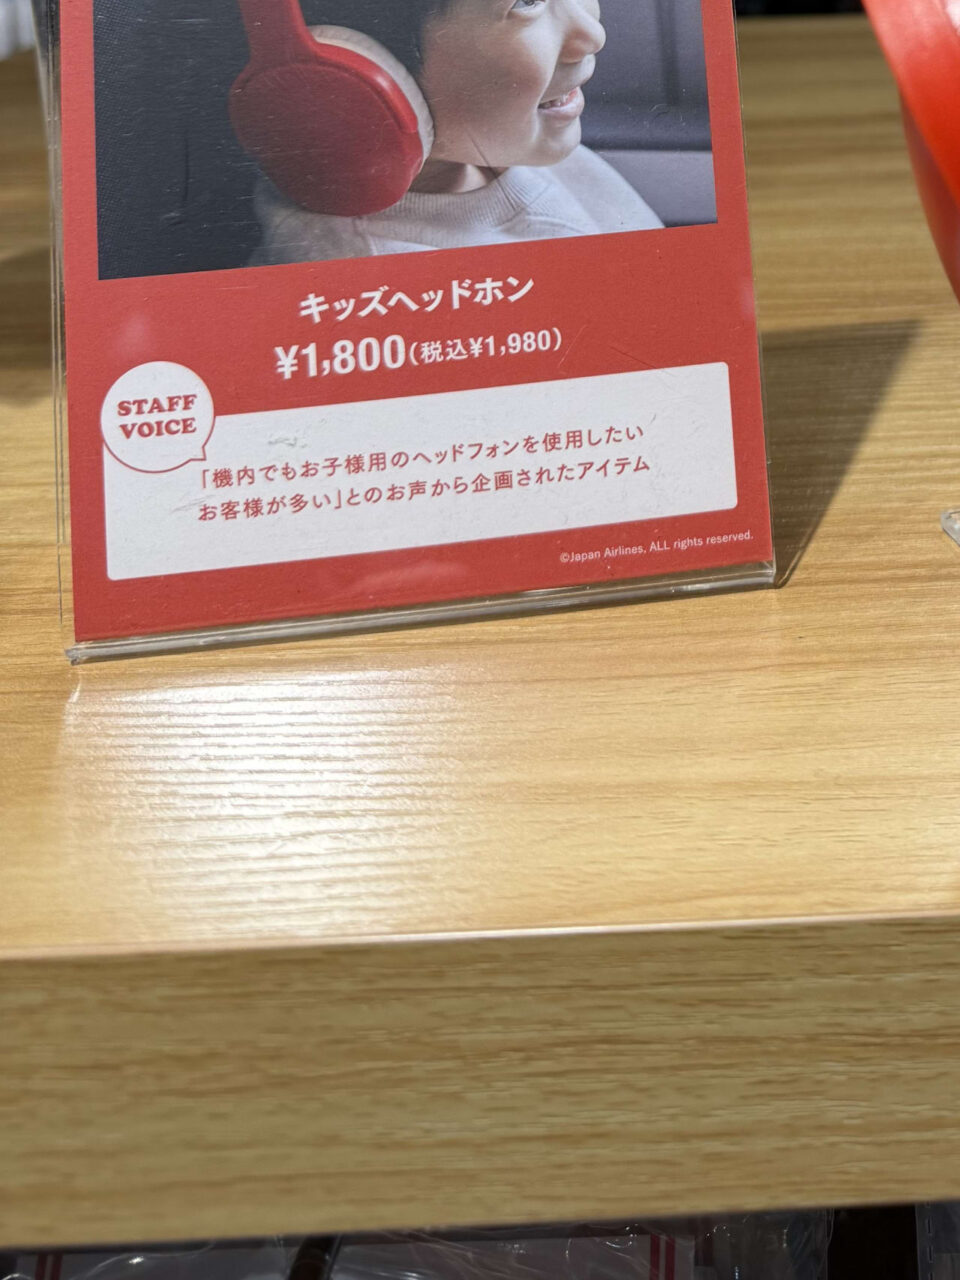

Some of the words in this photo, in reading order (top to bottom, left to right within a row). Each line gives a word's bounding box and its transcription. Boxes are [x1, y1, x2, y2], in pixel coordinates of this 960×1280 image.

[300, 276, 535, 324] キッズヘッドホン
[117, 393, 198, 417] STAFF
[118, 417, 198, 440] VOICE
[202, 425, 645, 489] 「機内でもお子様用のヘッドフォンを使用したい
[198, 455, 652, 521] お客様が多い」とのお声から企画されたアイテム
[650, 541, 670, 552] ALL
[673, 537, 704, 551] rights
[706, 529, 754, 546] reserved.
